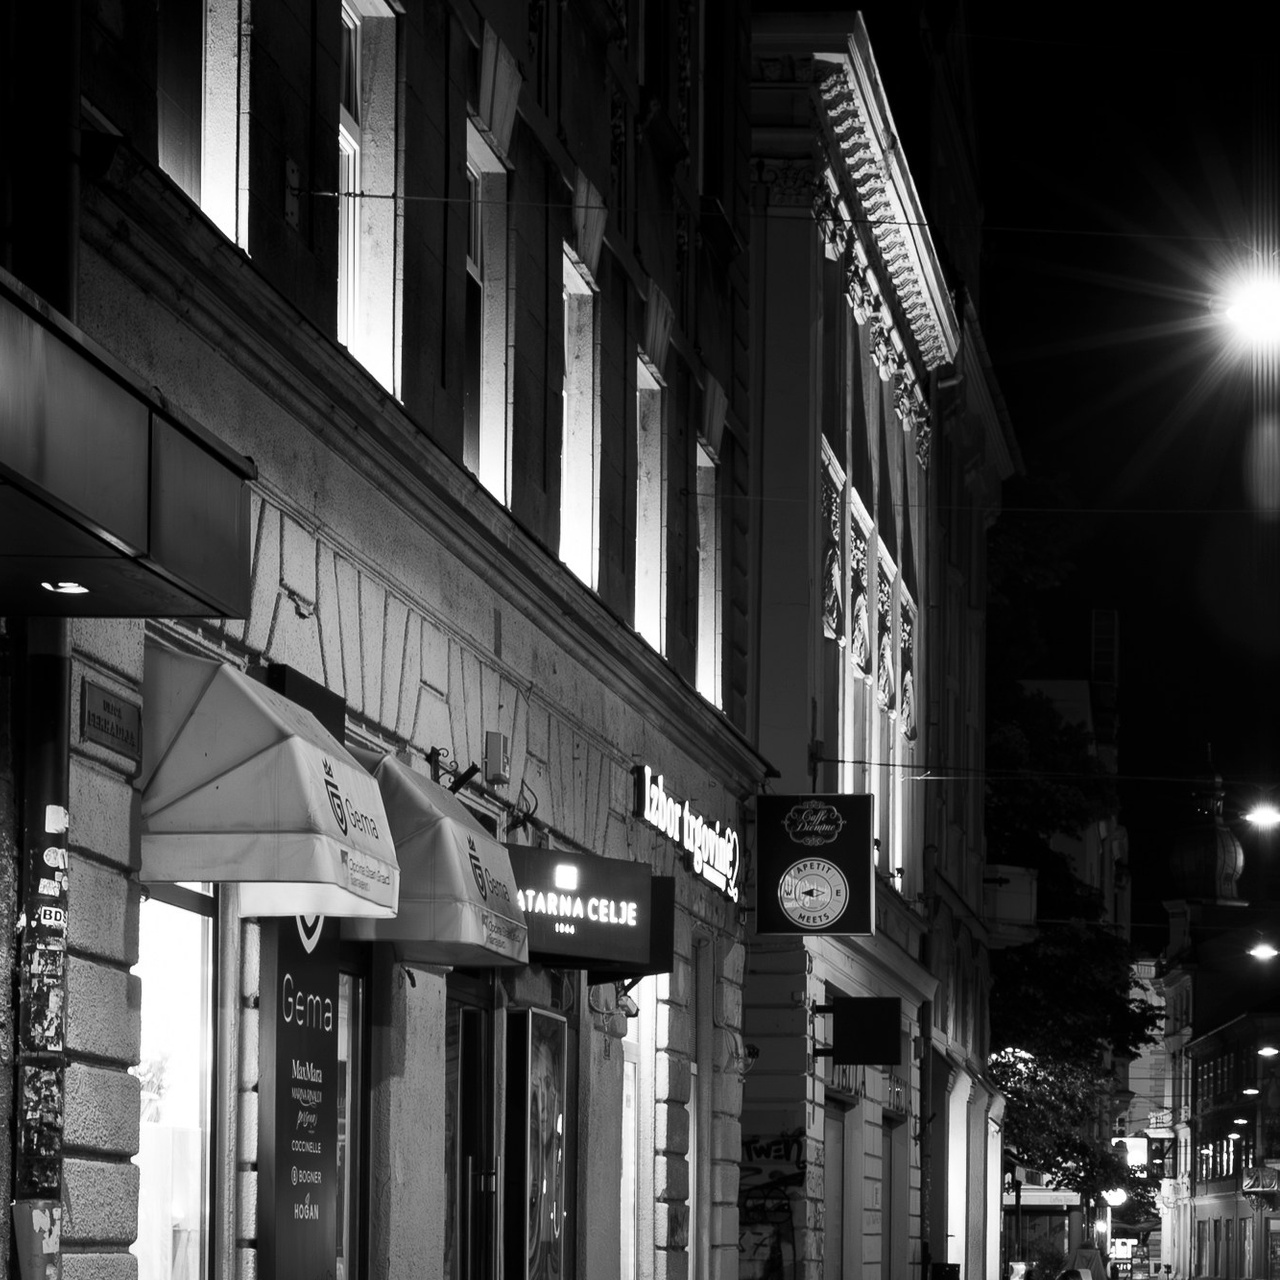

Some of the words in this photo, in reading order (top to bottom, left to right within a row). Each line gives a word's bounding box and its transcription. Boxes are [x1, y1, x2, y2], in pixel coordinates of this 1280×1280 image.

[644, 765, 681, 842] Izbor
[345, 798, 379, 839] Gema
[796, 862, 832, 875] APETIT
[587, 897, 637, 926] CELJE
[798, 912, 830, 924] MEETS
[282, 973, 333, 1032] Gema
[291, 1058, 323, 1083] MaxMara
[291, 1140, 322, 1154] COCCINELLE
[299, 1170, 322, 1184] BOGNER
[294, 1203, 319, 1220] HOGAN
